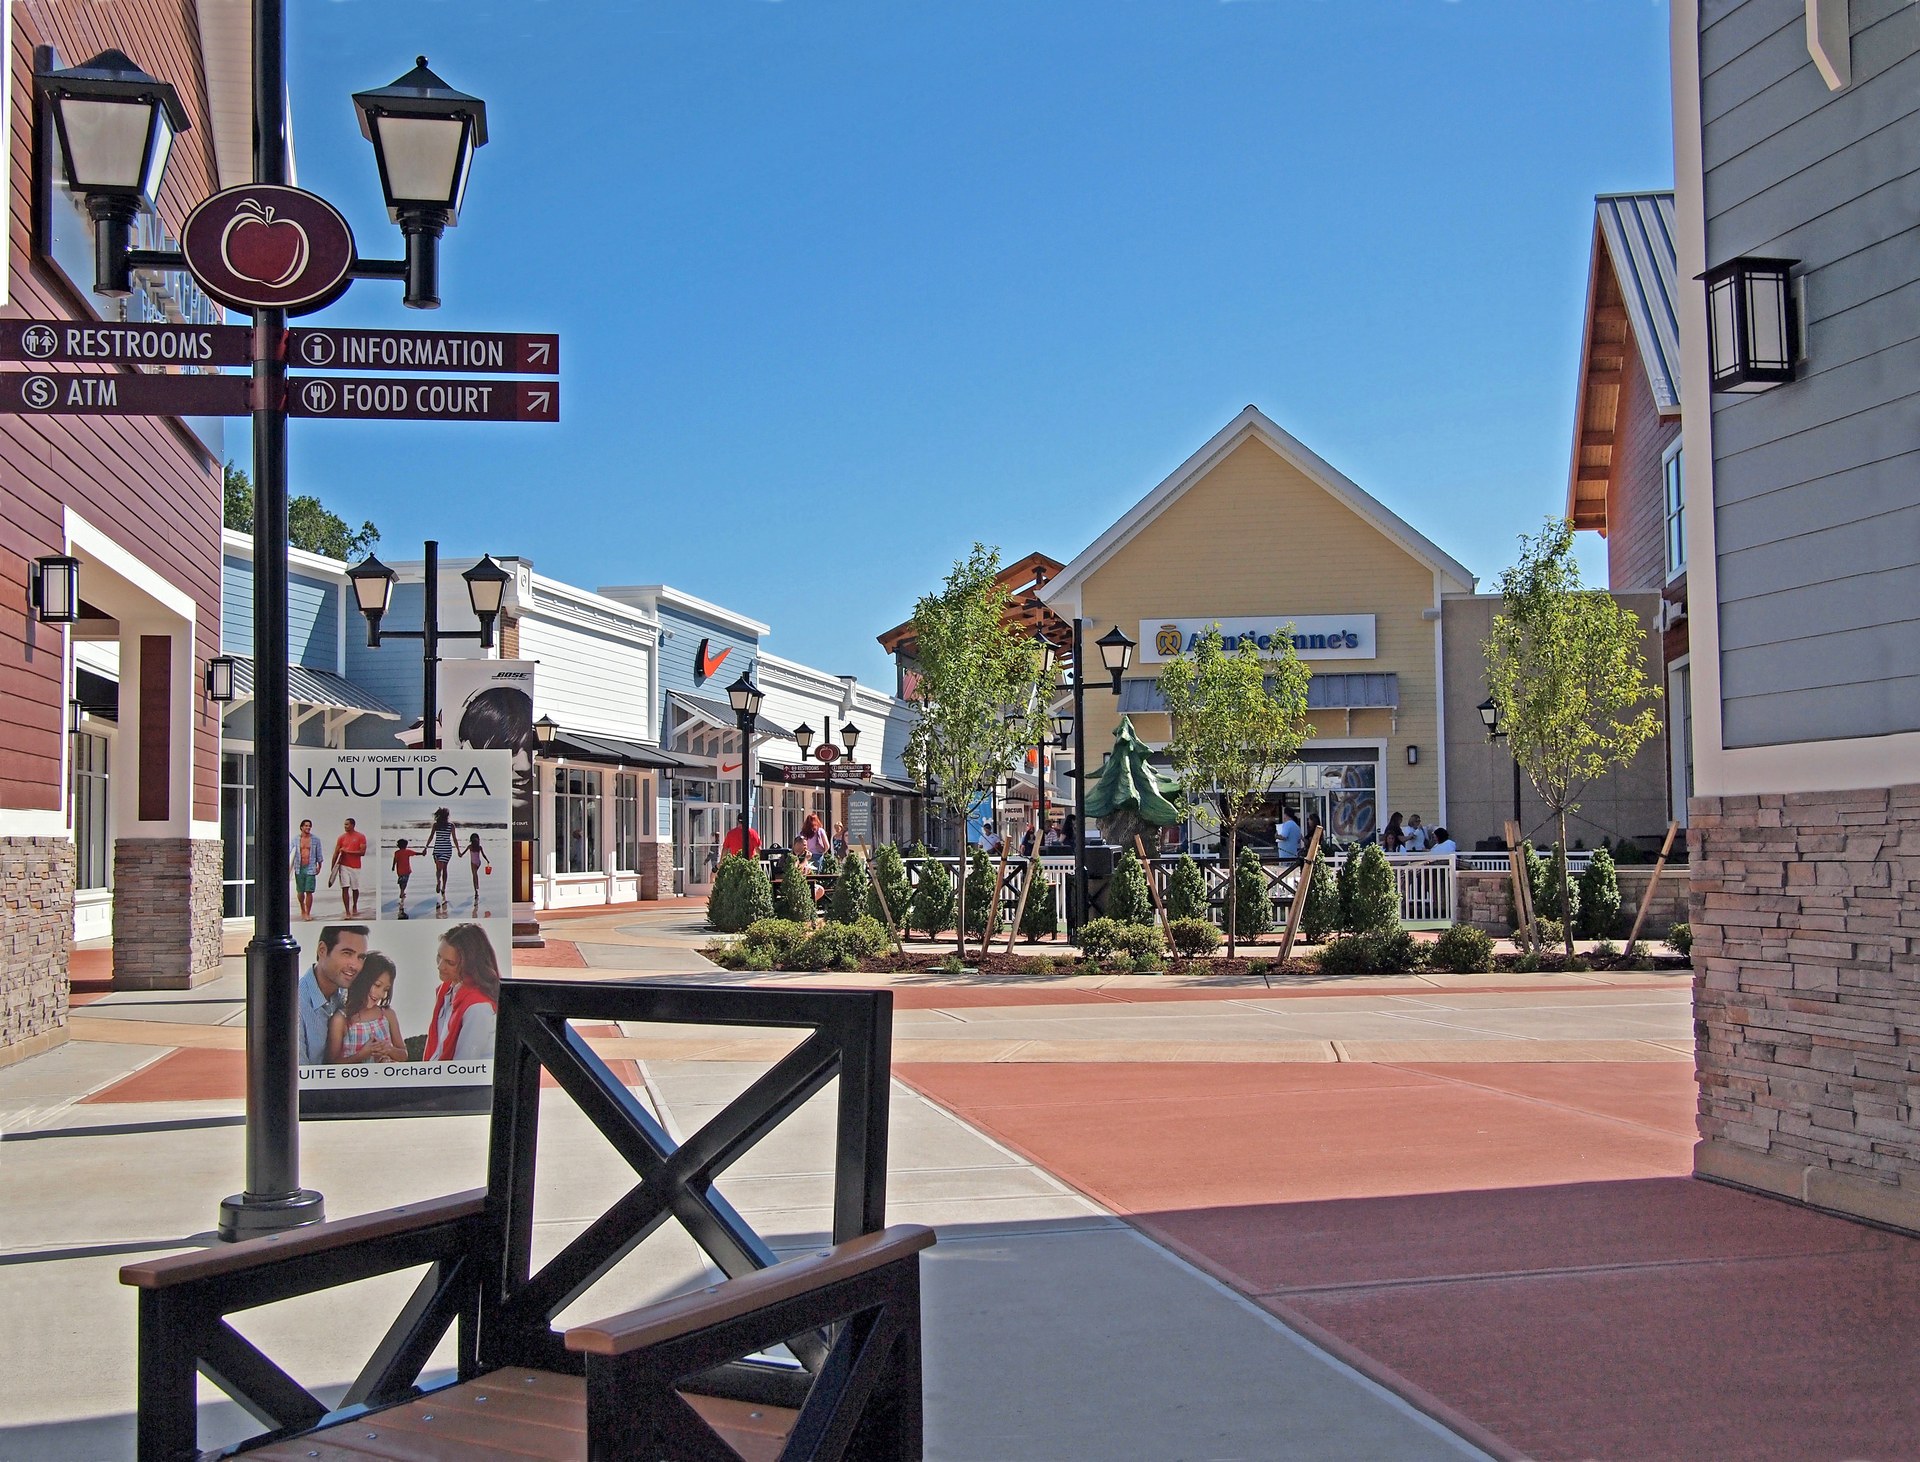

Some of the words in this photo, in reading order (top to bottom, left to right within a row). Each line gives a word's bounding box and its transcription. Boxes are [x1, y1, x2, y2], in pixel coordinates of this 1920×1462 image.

[66, 329, 213, 359] RESTROOMS
[342, 337, 503, 367] INFORMATION
[66, 379, 118, 406] ATM
[343, 384, 408, 411] FOOD
[416, 386, 493, 413] COURT
[1272, 629, 1359, 649] nne's
[494, 671, 530, 679] BOSE
[337, 755, 360, 763] MEN
[367, 755, 406, 763] WOMEN
[288, 766, 492, 797] NAUTICA
[298, 1068, 336, 1080] UITE
[341, 1067, 370, 1079] 609
[383, 1064, 442, 1078] Orchard
[447, 1063, 487, 1075] Court
